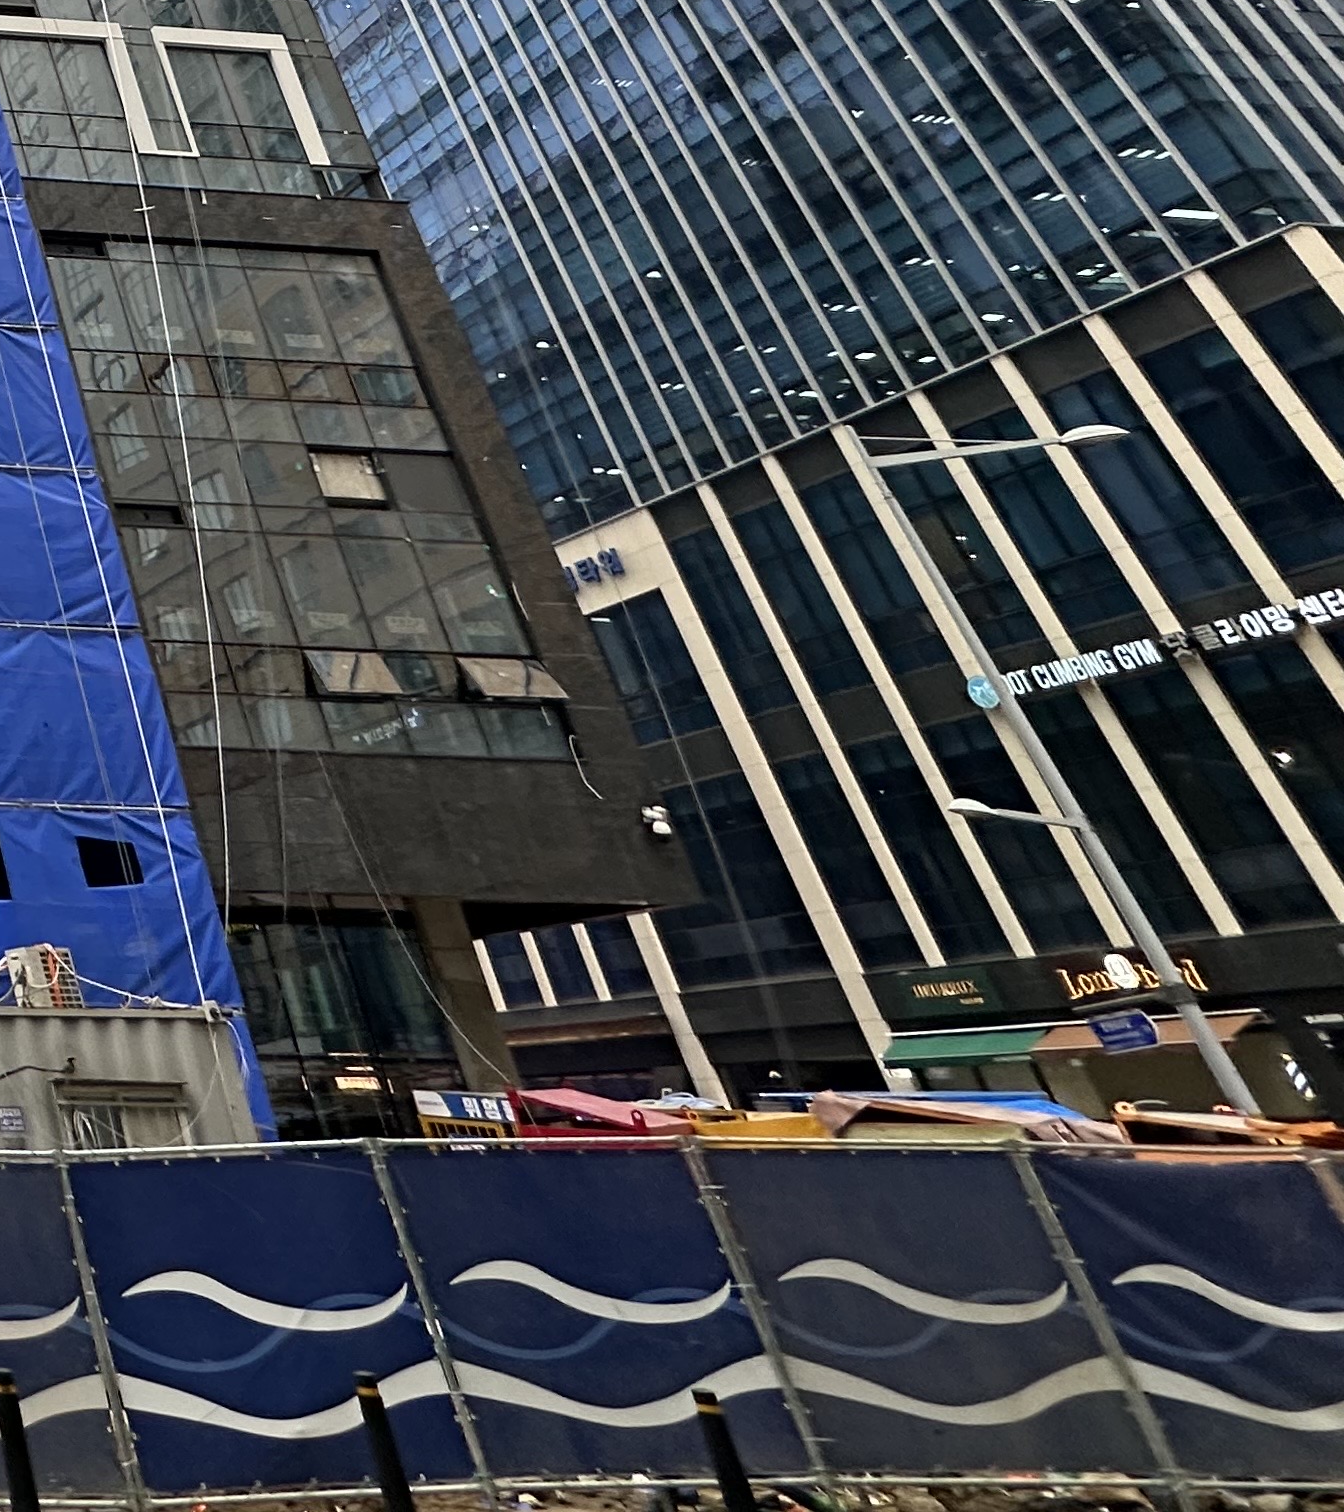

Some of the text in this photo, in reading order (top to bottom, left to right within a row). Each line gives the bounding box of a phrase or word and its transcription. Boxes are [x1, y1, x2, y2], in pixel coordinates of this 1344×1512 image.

[564, 546, 626, 594] 타워
[1191, 604, 1296, 651] 클라이밍
[1030, 648, 1119, 690] CLIMBING
[1112, 638, 1164, 671] GYM
